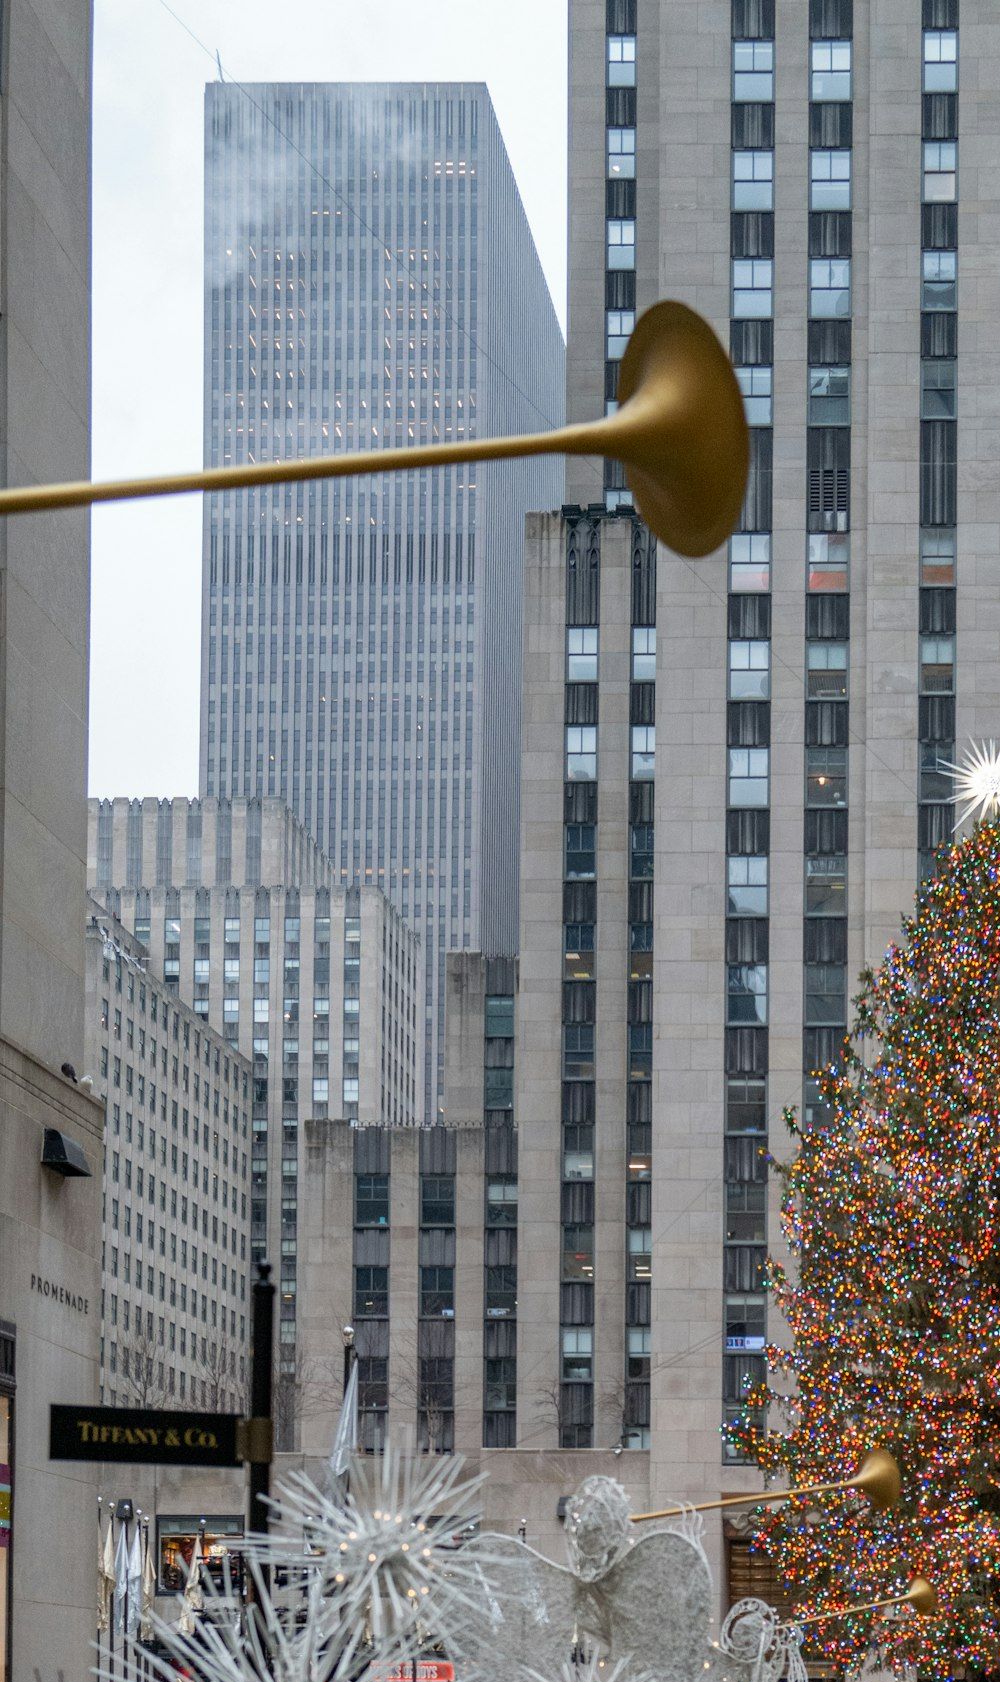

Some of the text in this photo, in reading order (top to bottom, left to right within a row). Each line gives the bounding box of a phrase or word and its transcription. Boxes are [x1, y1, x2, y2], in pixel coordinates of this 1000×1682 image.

[31, 1272, 89, 1315] PROMENADE
[76, 1420, 160, 1446] TIFFANY
[164, 1427, 180, 1447] &
